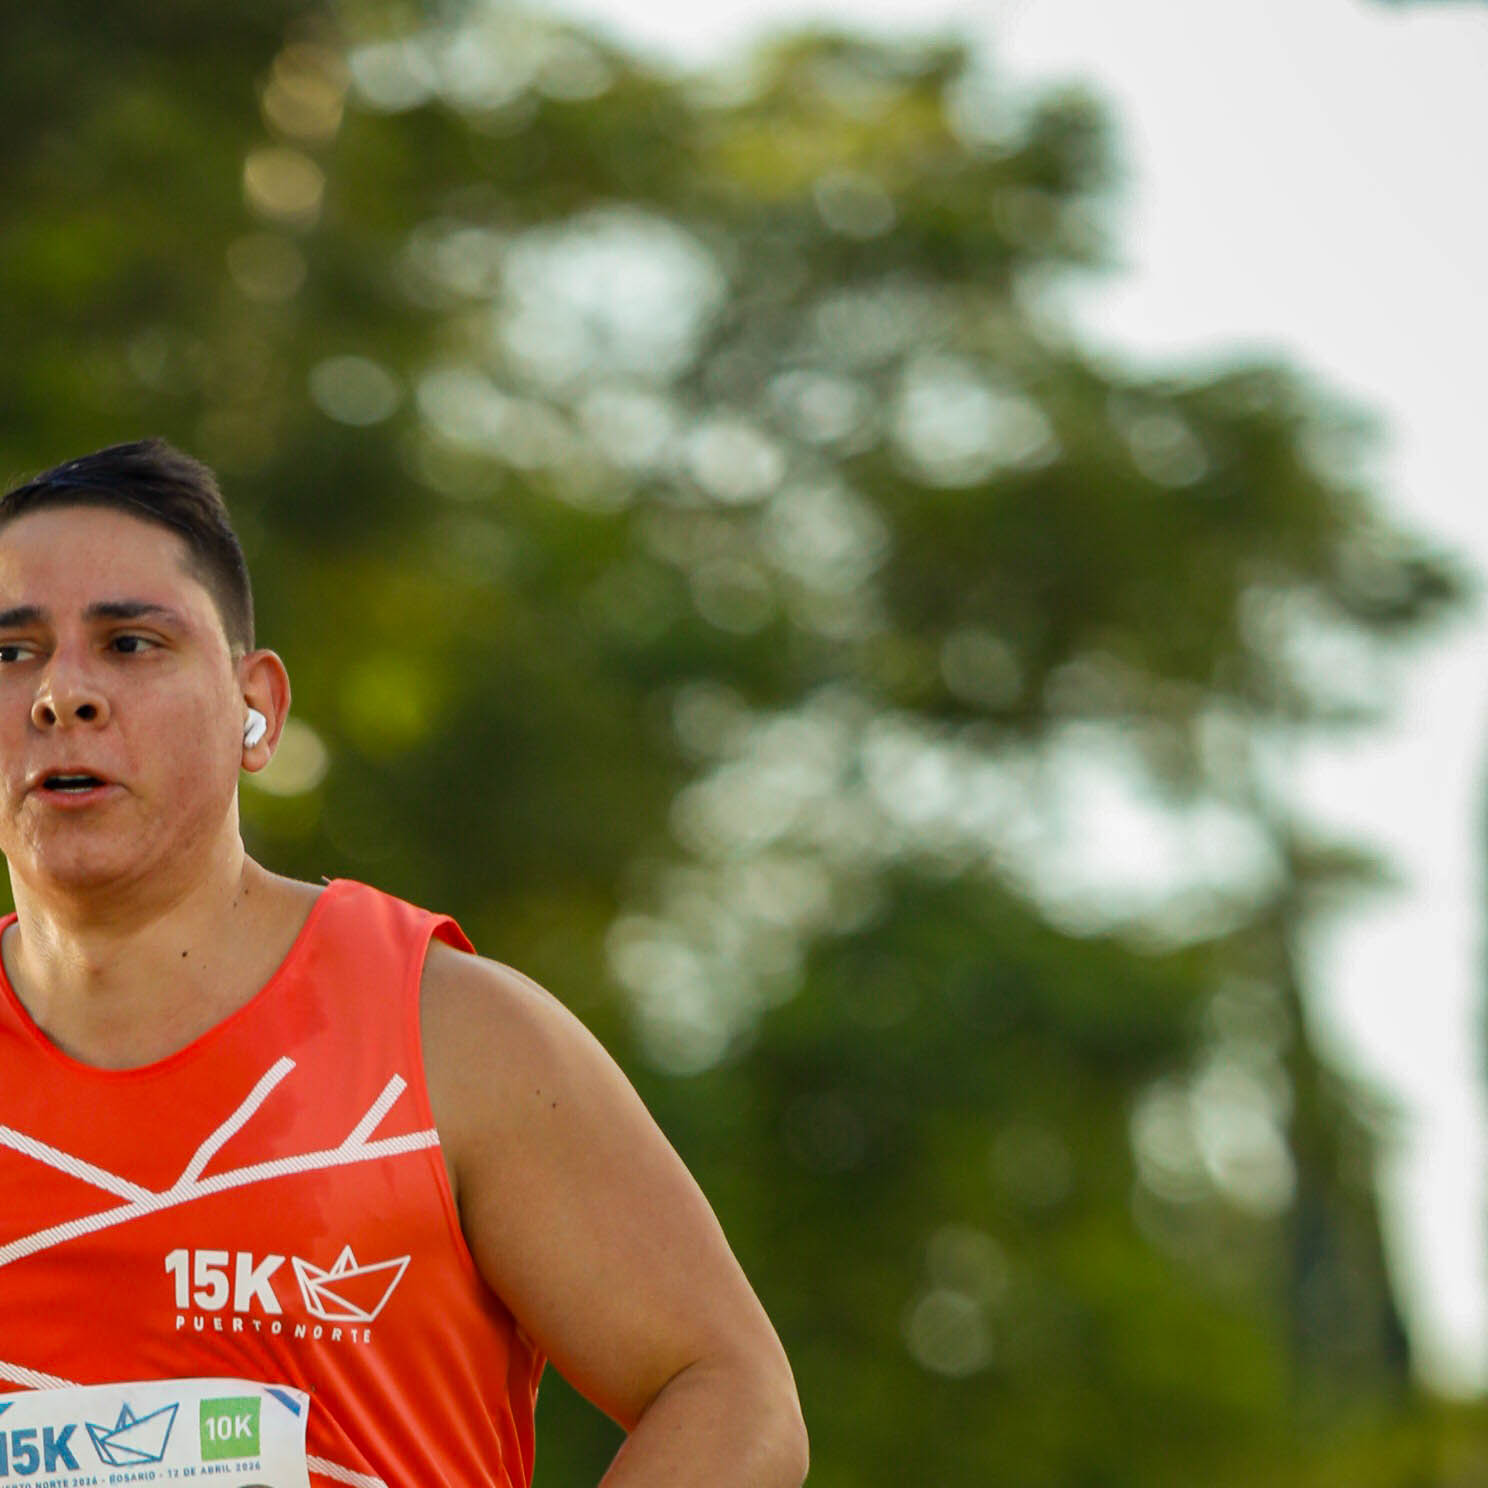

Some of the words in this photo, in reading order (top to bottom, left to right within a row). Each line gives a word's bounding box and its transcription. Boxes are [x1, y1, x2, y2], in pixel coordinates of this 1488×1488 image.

[165, 1249, 286, 1315] 15K
[205, 1415, 253, 1442] 10K
[109, 1471, 156, 1486] ROSARIO
[183, 1466, 196, 1477] DE
[200, 1463, 231, 1475] ABRIL
